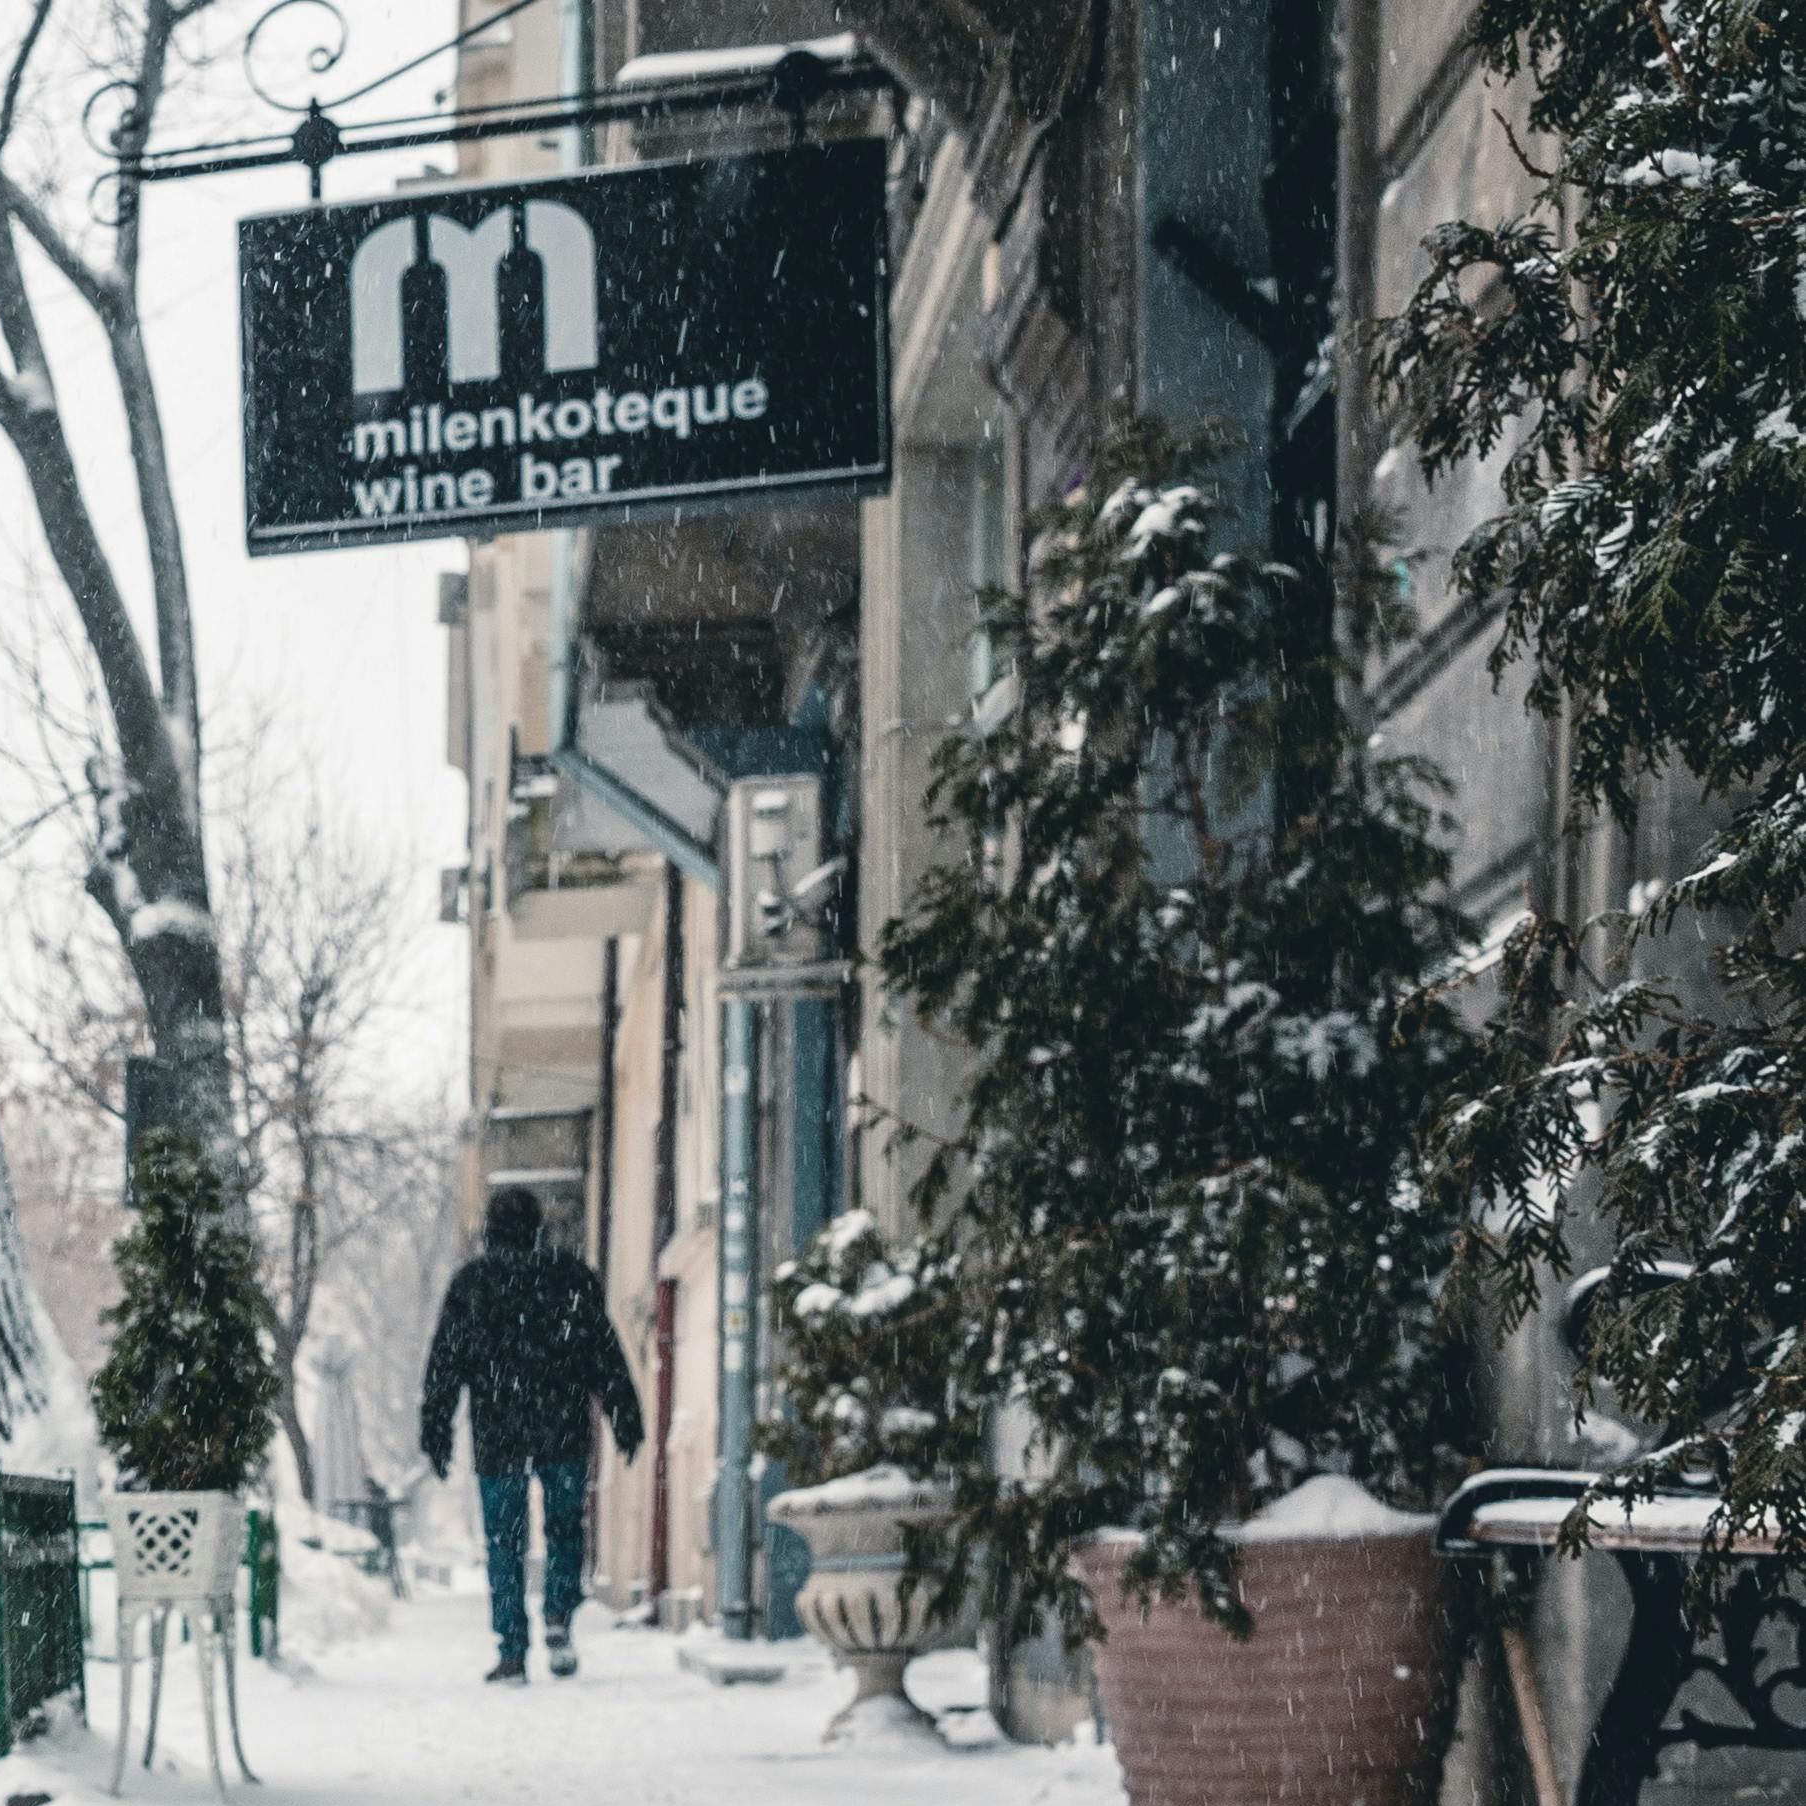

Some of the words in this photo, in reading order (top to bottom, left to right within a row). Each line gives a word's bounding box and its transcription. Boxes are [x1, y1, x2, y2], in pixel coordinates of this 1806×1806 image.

[353, 379, 768, 461] milenkoteque
[353, 465, 494, 516] wine
[520, 452, 621, 500] bar
